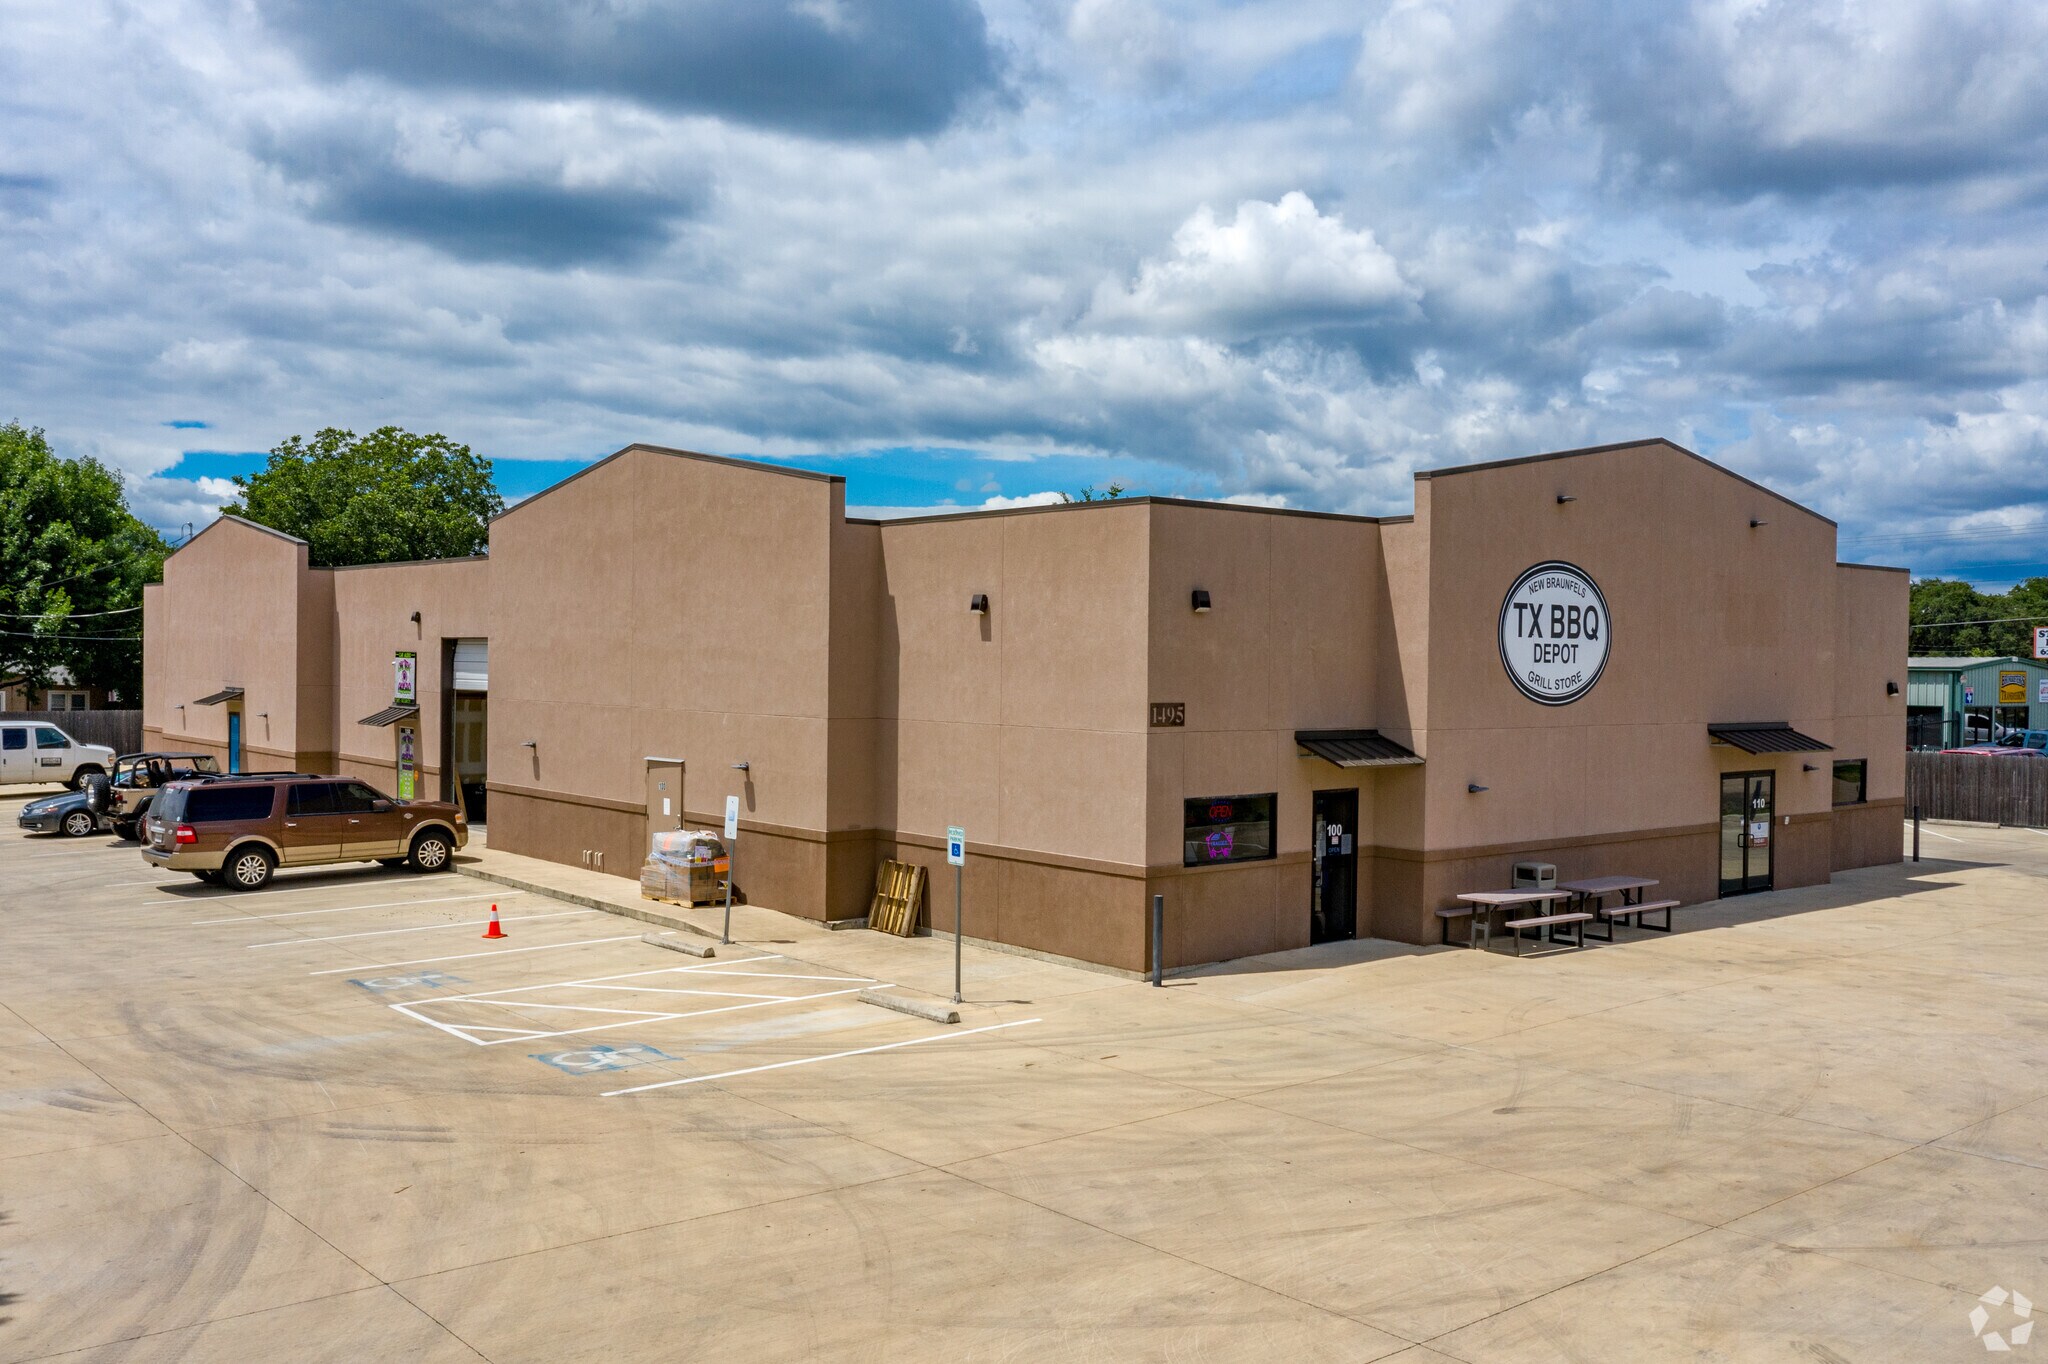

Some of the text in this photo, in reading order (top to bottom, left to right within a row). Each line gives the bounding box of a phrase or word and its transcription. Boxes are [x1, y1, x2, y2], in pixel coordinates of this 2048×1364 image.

[1528, 577, 1587, 598] NEW BRAUNFELS
[1513, 602, 1599, 641] TX BBQ
[1533, 643, 1579, 664] DEPOT
[1528, 670, 1583, 690] GRILL STORE
[1152, 706, 1184, 723] 1495
[1209, 805, 1232, 817] OPEN
[1752, 798, 1766, 808] 110
[1327, 824, 1342, 836] 100
